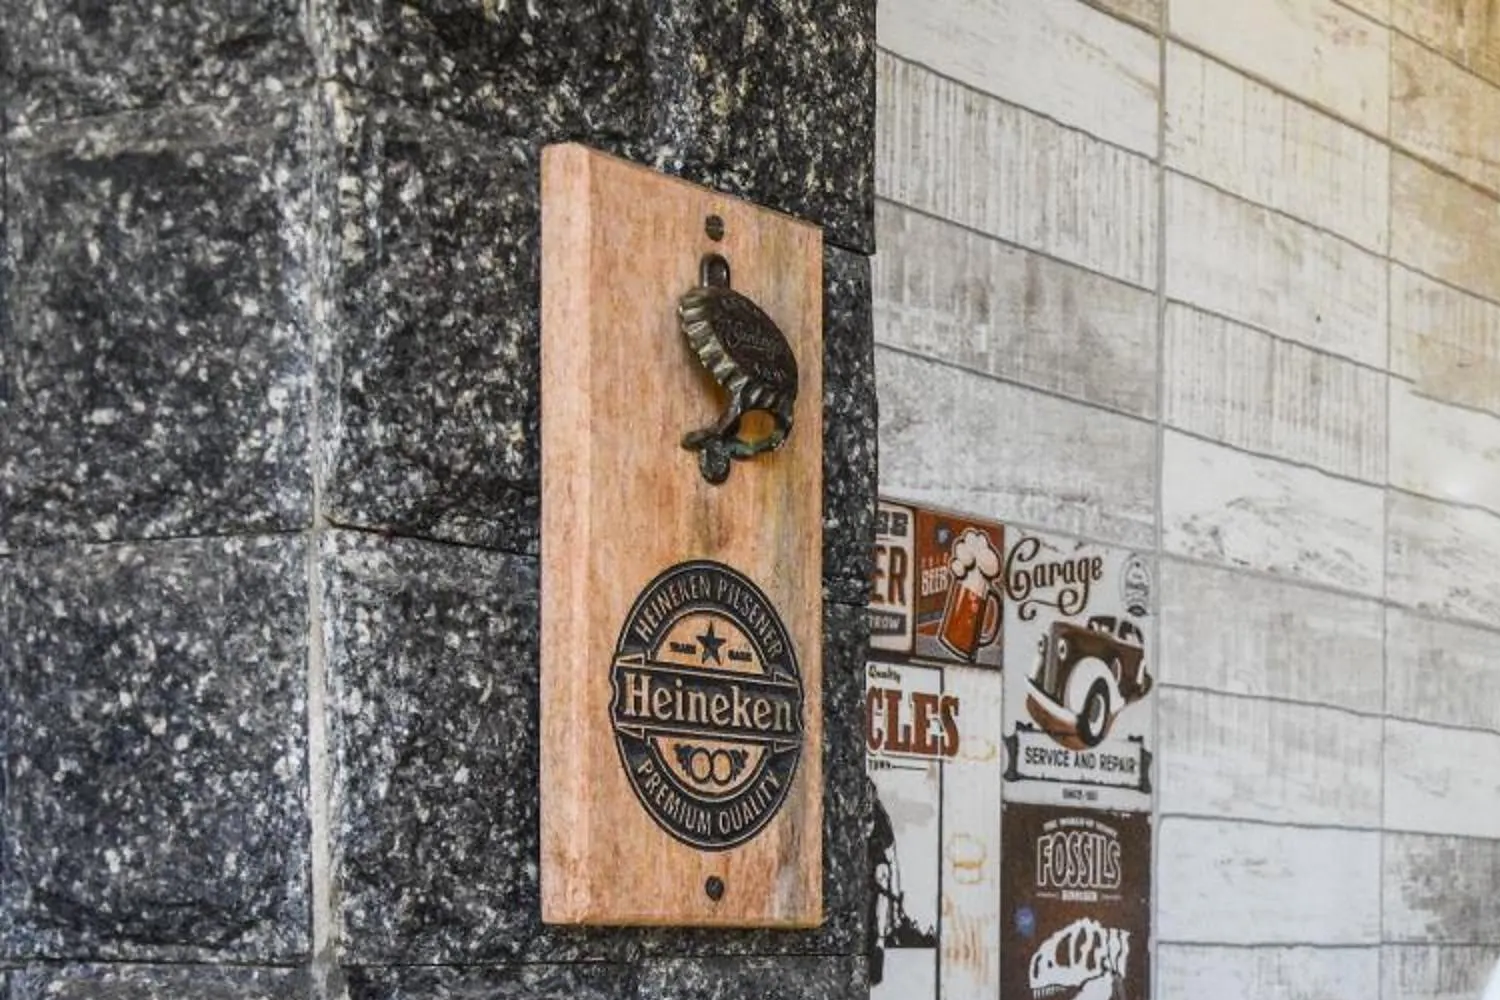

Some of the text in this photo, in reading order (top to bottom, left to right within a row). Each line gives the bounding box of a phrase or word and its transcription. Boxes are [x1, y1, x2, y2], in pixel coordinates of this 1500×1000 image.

[1004, 537, 1103, 621] Garage
[635, 574, 784, 656] HEINEKEN PILSENER
[622, 670, 795, 732] Heineken
[867, 686, 960, 757] CLES
[1024, 746, 1137, 774] SERVICE AND REPAIR
[637, 757, 782, 837] PREMIUM QUALITY
[1037, 832, 1121, 889] FOSSILS
